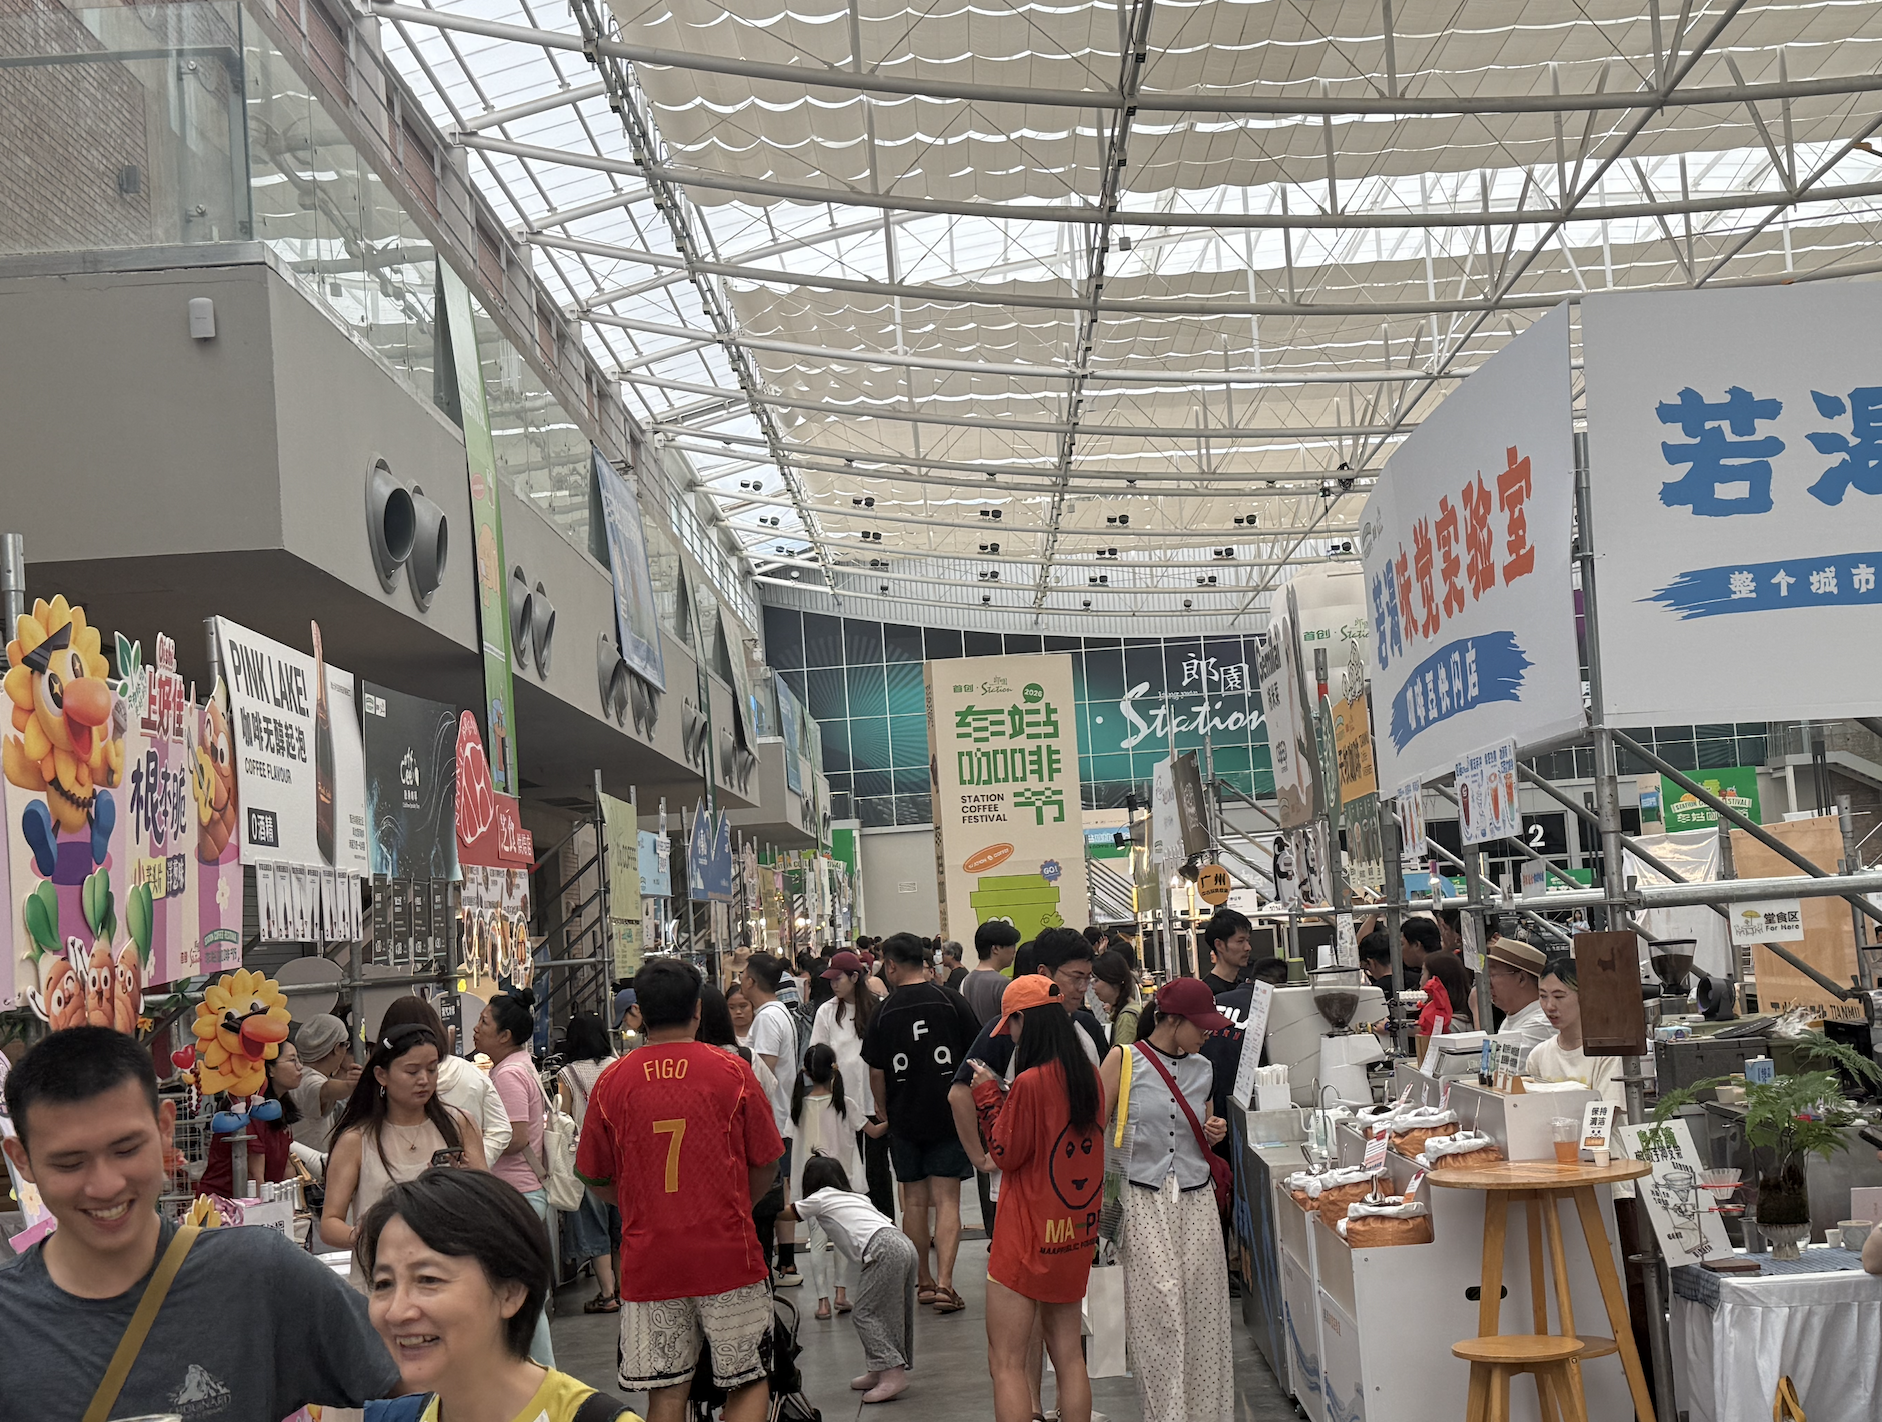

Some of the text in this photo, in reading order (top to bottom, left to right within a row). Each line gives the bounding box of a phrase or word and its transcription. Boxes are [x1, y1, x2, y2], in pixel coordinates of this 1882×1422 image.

[228, 638, 310, 718] PINK LAKE!
[980, 680, 1014, 696] Station
[140, 667, 185, 739] 上好佳
[1023, 687, 1044, 698] 2026
[954, 702, 1060, 744] 车站
[1119, 680, 1267, 749] Station
[244, 757, 293, 785] COFFEE FLAVOUR
[957, 744, 1063, 787] 咖啡
[129, 750, 187, 846] 根本脆
[960, 793, 1005, 804] STATION
[961, 804, 999, 814] COFFEE
[1012, 787, 1066, 826] 节
[962, 813, 1009, 825] FESTIVAL
[1528, 824, 1547, 848] 2
[1043, 863, 1059, 875] GO!
[1200, 873, 1226, 889] 广州
[1763, 910, 1800, 925] 堂食区
[1829, 1004, 1861, 1020] TIANMU
[642, 1058, 689, 1082] FIGO
[652, 1118, 687, 1193] 7
